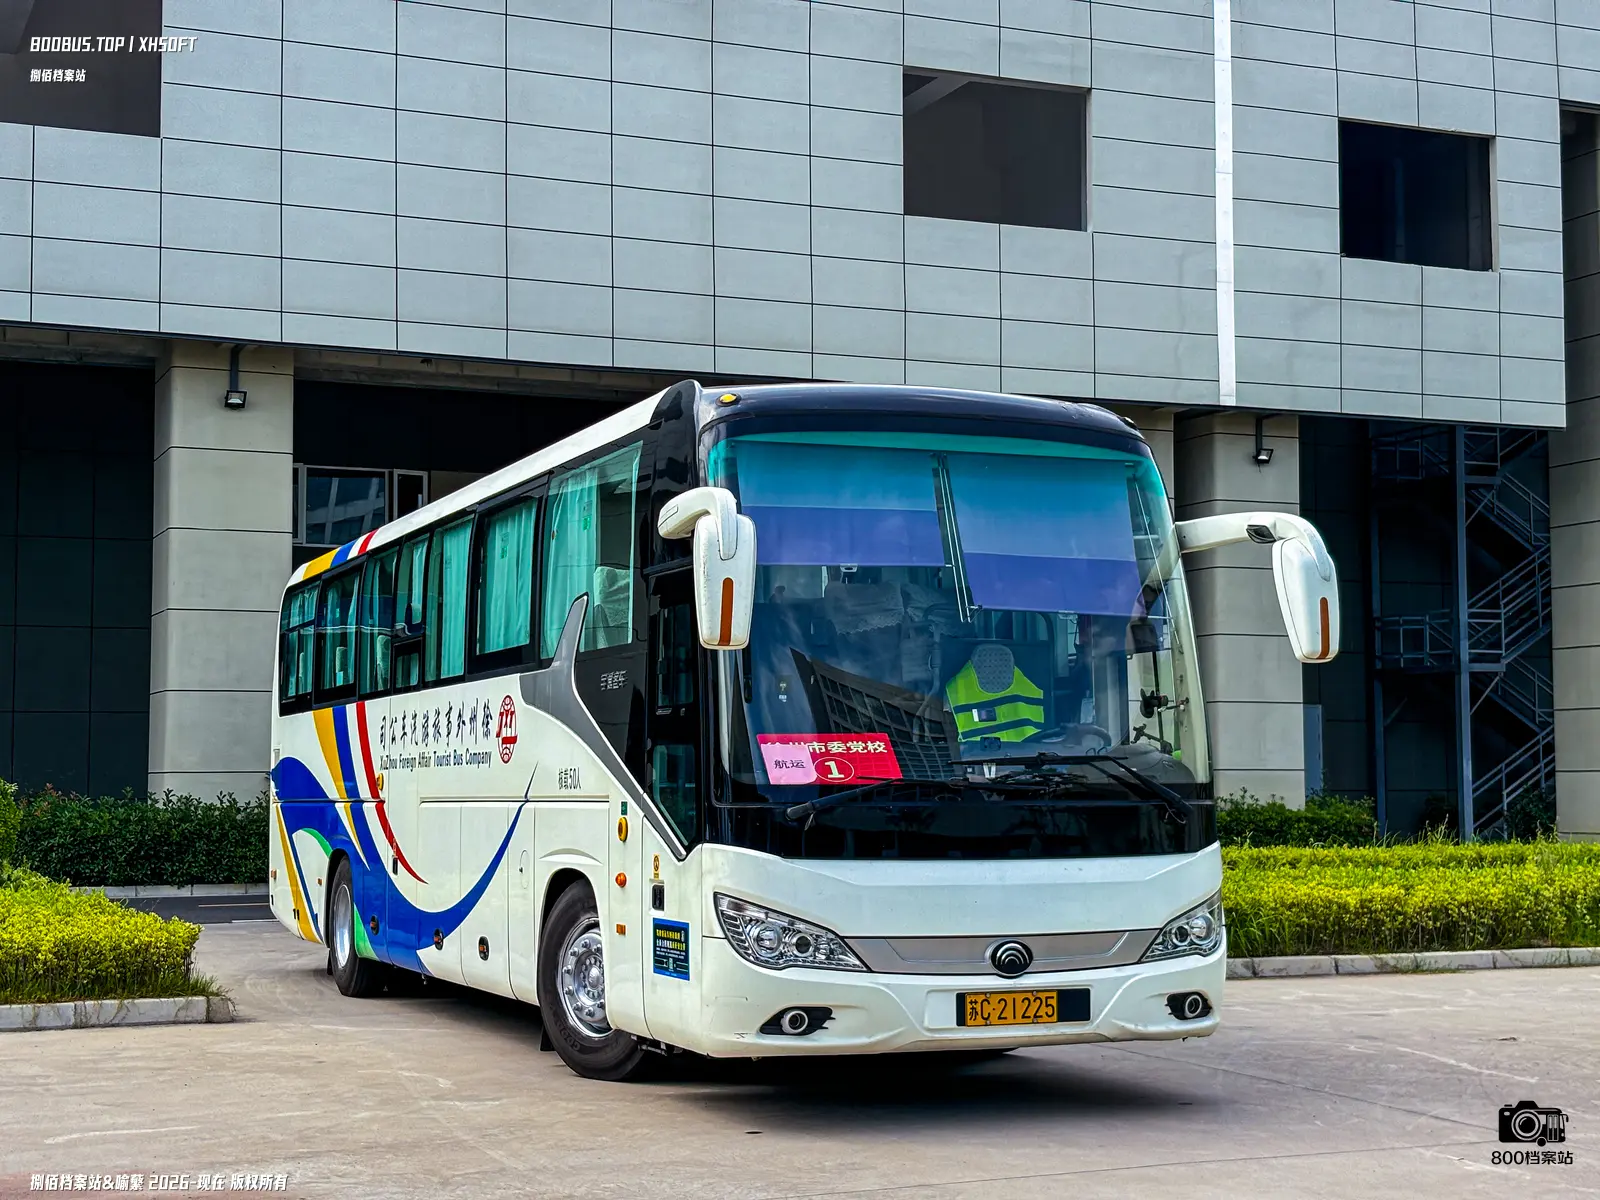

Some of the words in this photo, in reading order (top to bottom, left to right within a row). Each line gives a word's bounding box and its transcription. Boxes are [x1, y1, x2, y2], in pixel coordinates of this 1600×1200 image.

[399, 753, 417, 772] Foreign
[418, 751, 432, 768] Affair
[433, 750, 452, 768] Tourist
[453, 749, 464, 766] Bus
[465, 747, 493, 769] Company
[773, 759, 806, 769] 航运
[824, 760, 845, 779] 1
